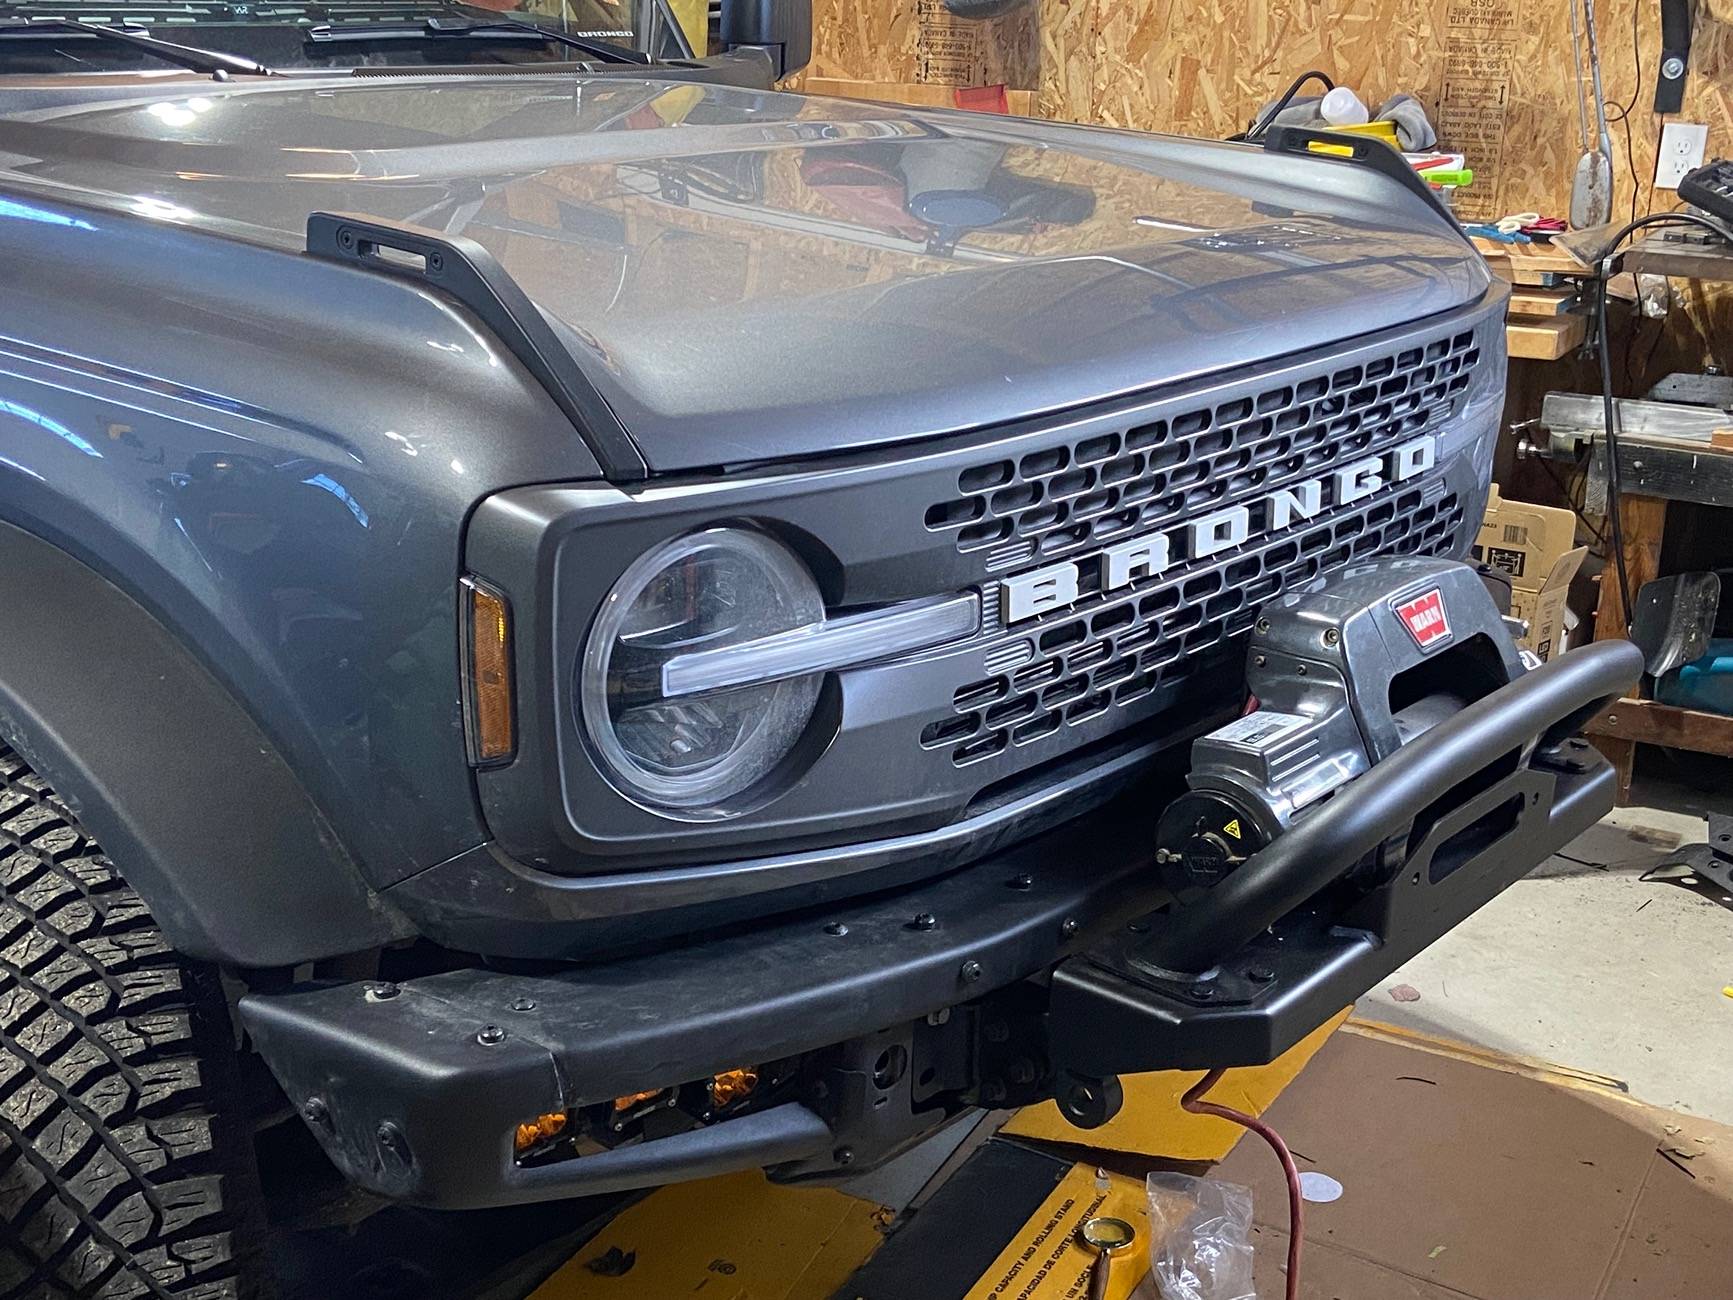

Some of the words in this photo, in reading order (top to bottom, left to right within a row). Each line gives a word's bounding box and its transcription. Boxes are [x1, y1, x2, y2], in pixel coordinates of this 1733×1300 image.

[1469, 16, 1501, 25] CANADA
[1001, 435, 1435, 623] BRONCO
[1410, 606, 1441, 632] WARN
[995, 1260, 1025, 1292] CAPACITY
[1021, 1246, 1037, 1261] AND
[1032, 1219, 1059, 1247] ROLLING
[1055, 1198, 1075, 1220] STAND
[1017, 1269, 1047, 1300] APACIDAD
[1043, 1260, 1056, 1271] DE
[1051, 1237, 1070, 1260] CORTE
[1066, 1287, 1077, 1299] UN
